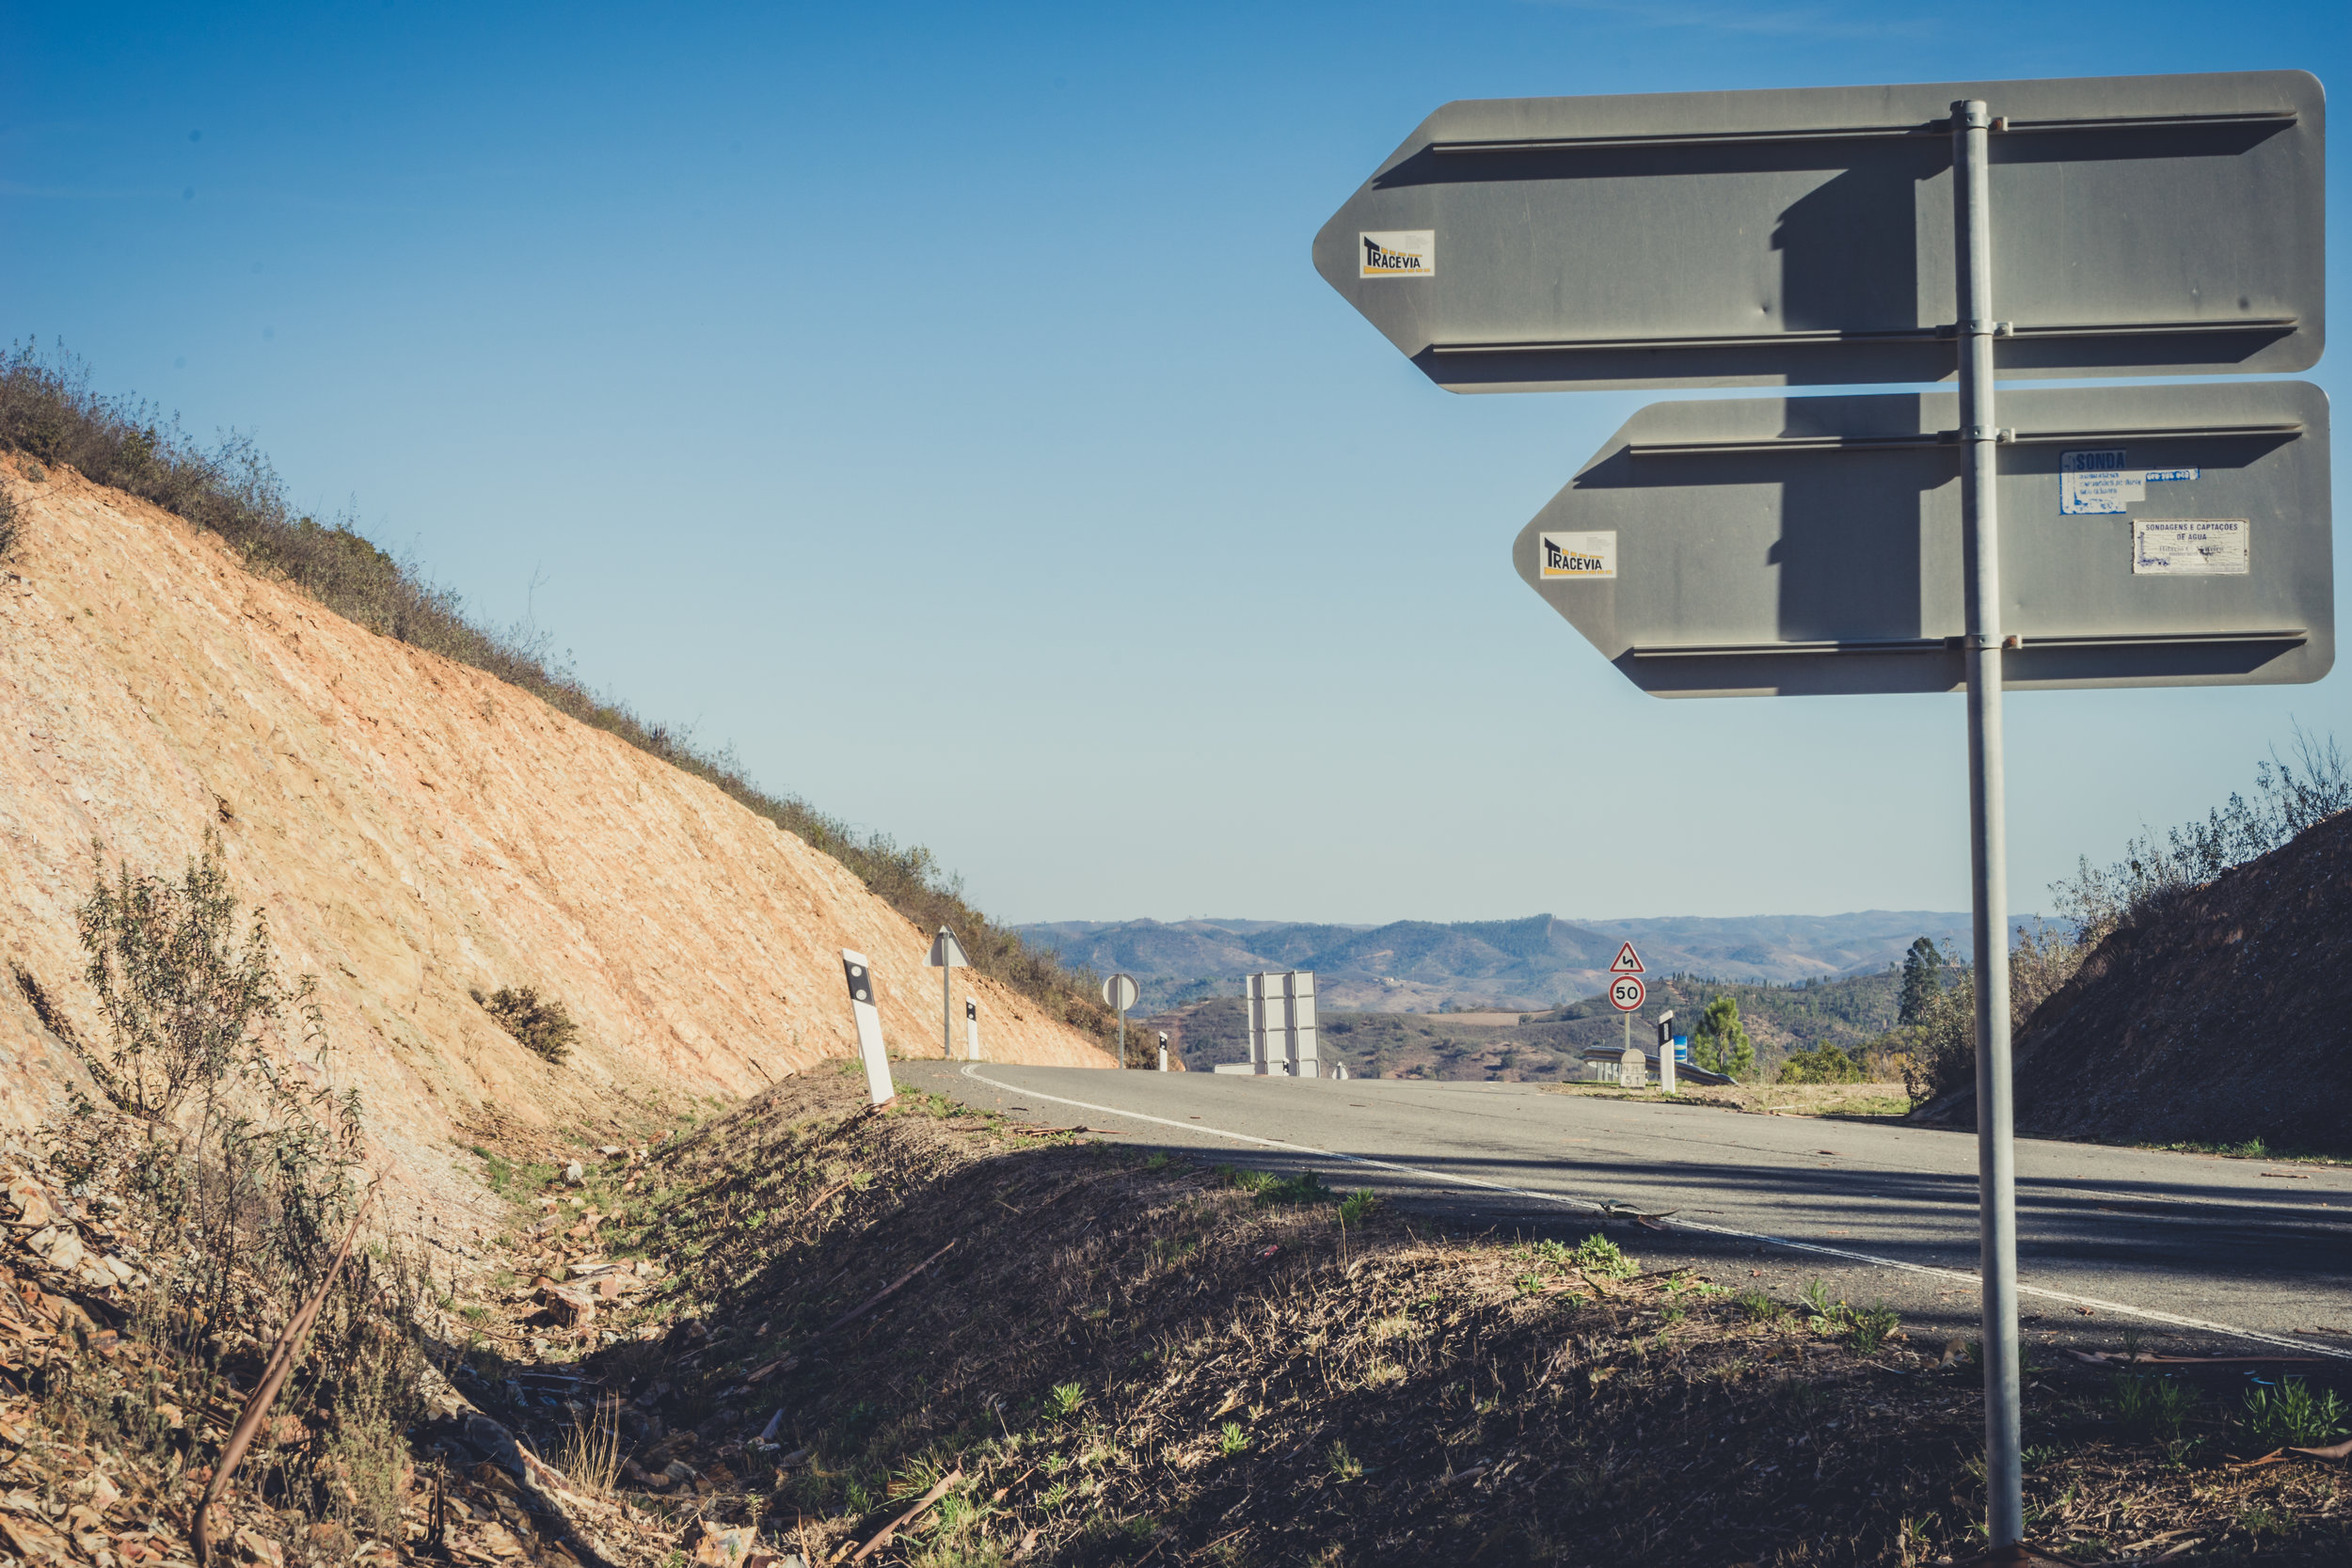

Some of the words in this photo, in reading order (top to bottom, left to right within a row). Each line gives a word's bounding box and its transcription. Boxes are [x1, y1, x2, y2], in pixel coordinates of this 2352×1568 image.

[1363, 235, 1421, 269] TRACEVIA
[2076, 451, 2124, 469] SONDA
[1544, 537, 1602, 570] TRACEVIA
[1615, 987, 1638, 1000] 50
